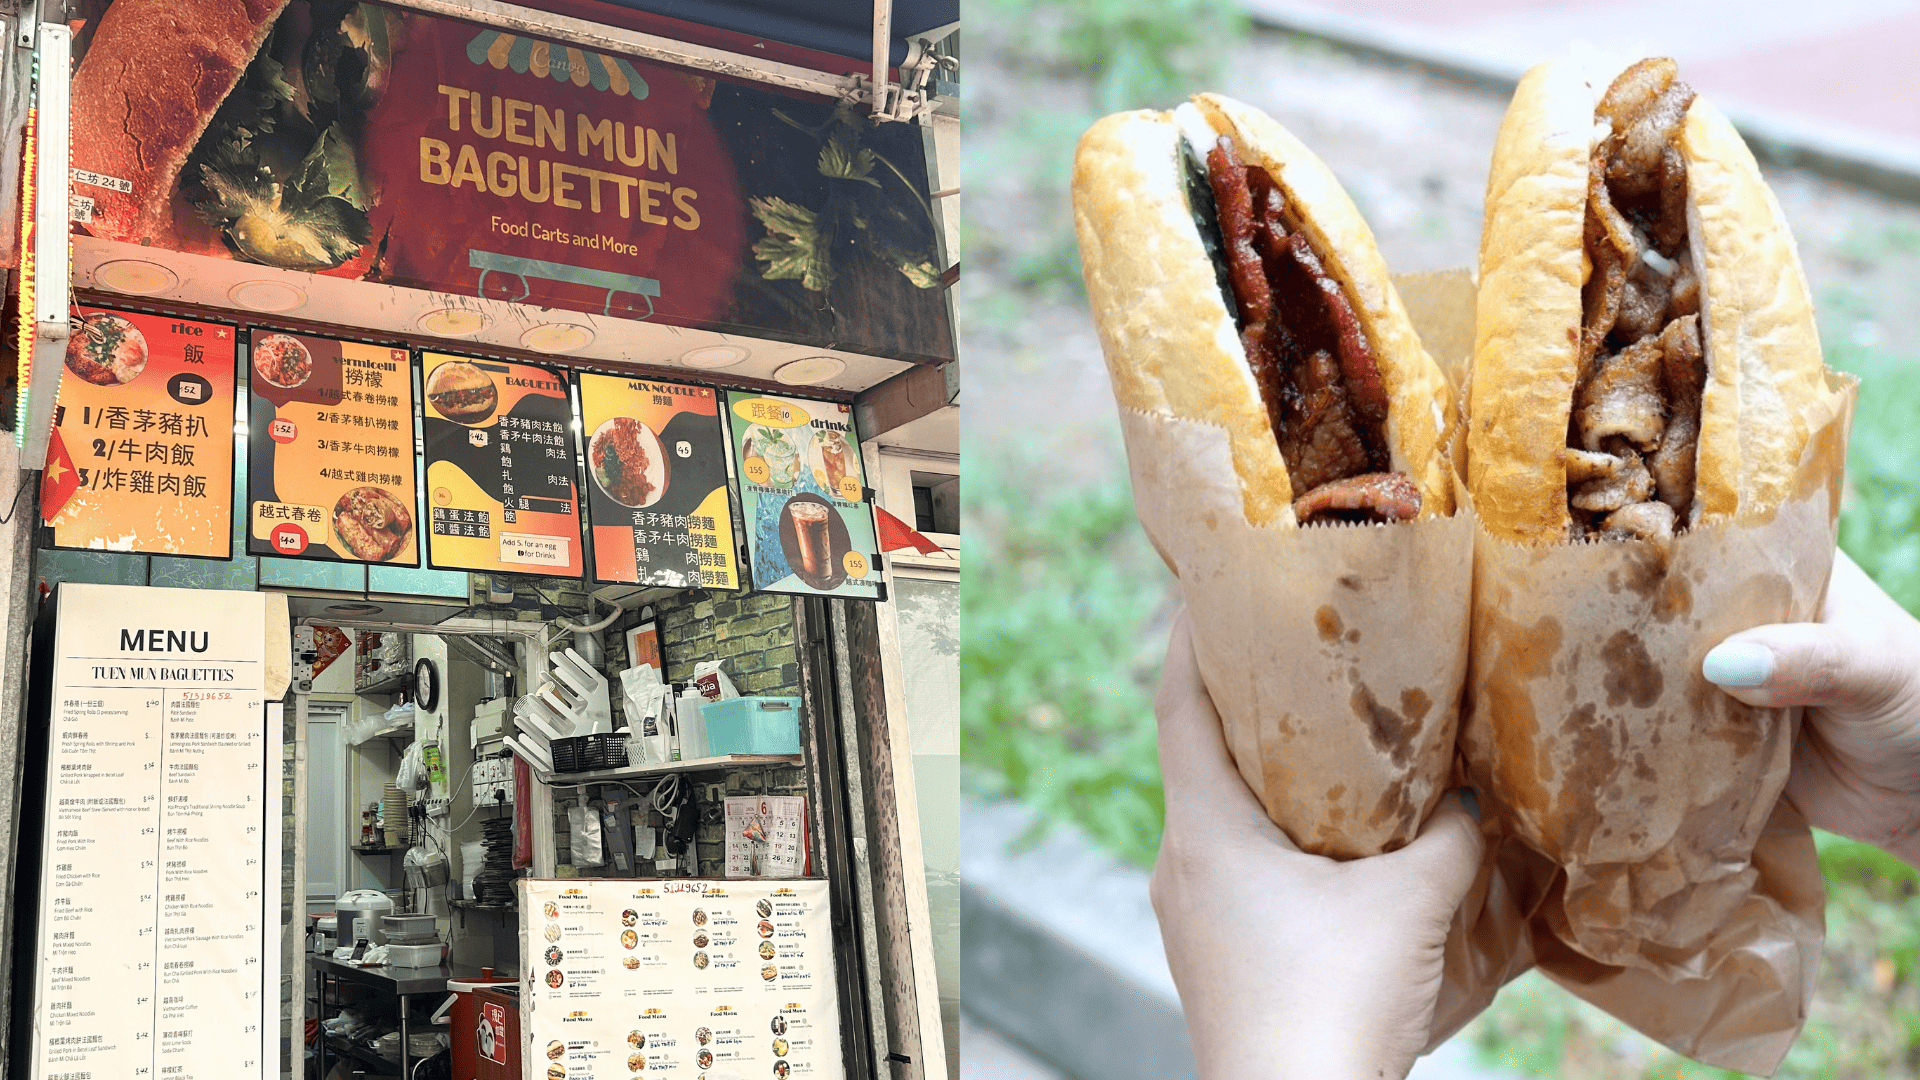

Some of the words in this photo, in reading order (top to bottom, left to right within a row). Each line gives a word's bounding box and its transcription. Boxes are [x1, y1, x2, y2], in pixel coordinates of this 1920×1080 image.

[532, 47, 587, 76] Canva
[437, 84, 566, 152] TUEN
[577, 113, 678, 175] MUN
[102, 177, 115, 188] 24
[419, 136, 701, 231] BAGUETTE'S
[491, 216, 529, 237] Food
[532, 223, 570, 244] Carts
[572, 233, 600, 250] and
[602, 236, 639, 256] More
[171, 323, 203, 337] rice
[183, 343, 205, 364] 飯
[332, 356, 397, 372] vermicelli
[505, 376, 566, 392] BAGUETT
[628, 382, 650, 392] MIX
[652, 384, 696, 397] NOODLE
[782, 411, 790, 419] 10
[810, 419, 853, 433] drinks
[545, 447, 567, 460] 肉法
[676, 445, 690, 455] 45
[501, 455, 513, 468] 飽
[749, 466, 763, 475] 15$
[547, 474, 569, 487] 肉法
[502, 483, 515, 495] 飽
[844, 483, 857, 493] 15$
[259, 503, 322, 523] 越式春卷
[504, 510, 516, 522] 飽
[502, 538, 516, 547] Add
[524, 540, 534, 548] for
[545, 543, 557, 551] egg
[524, 550, 534, 558] for
[535, 551, 556, 559] Drinks
[849, 560, 863, 569] 15$
[120, 628, 209, 653] MENU
[91, 666, 126, 680] TUEN
[130, 667, 157, 680] MUN
[160, 668, 234, 682] BAGUETTES
[182, 692, 233, 701] 51319652
[760, 801, 767, 815] 6
